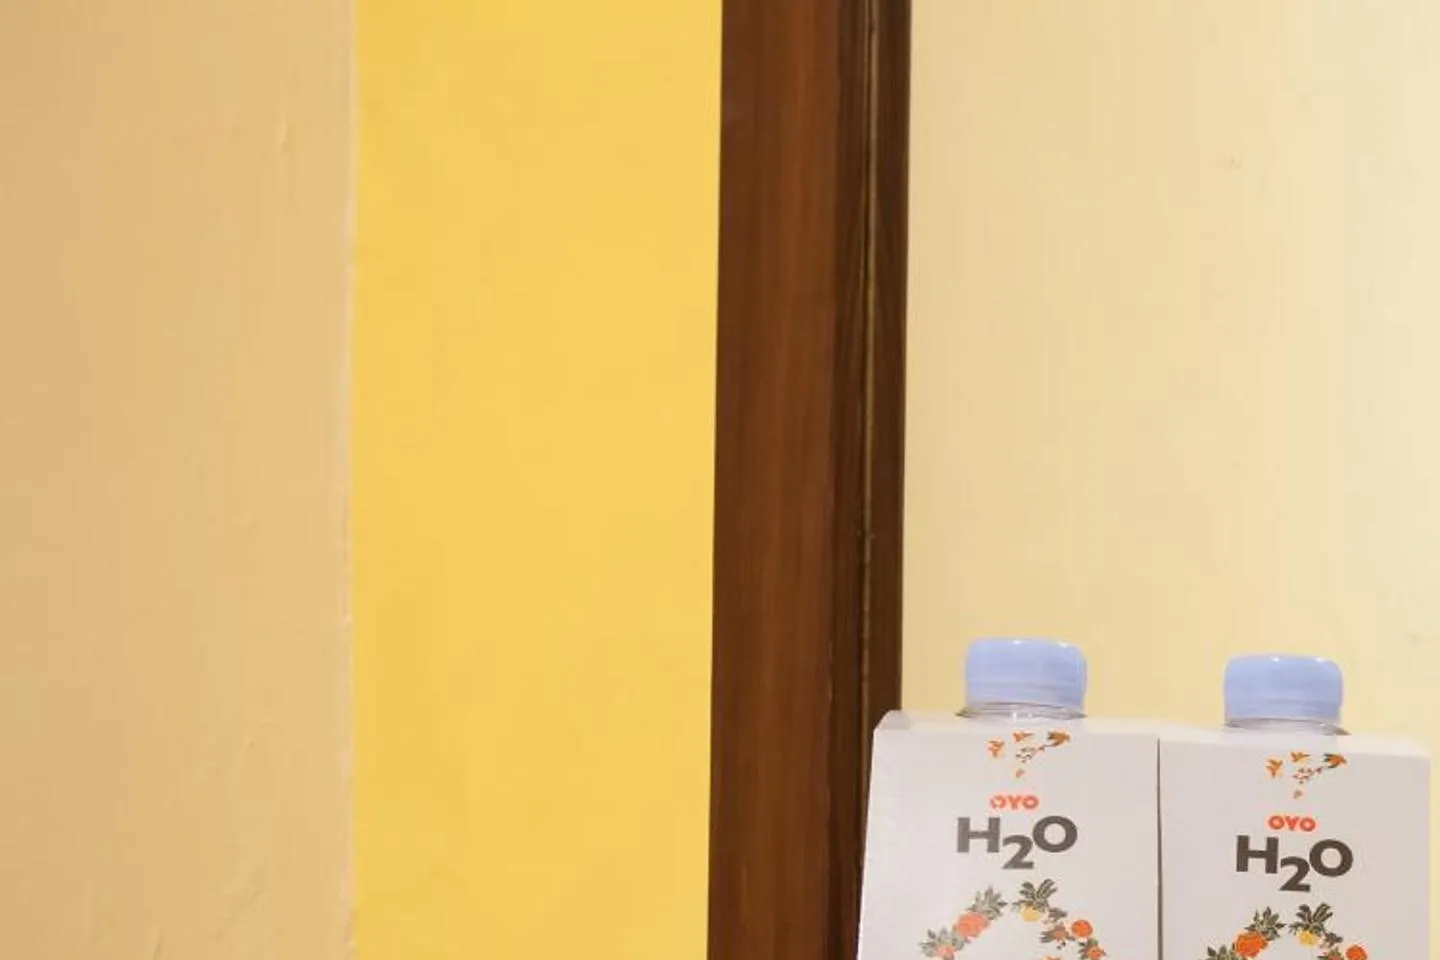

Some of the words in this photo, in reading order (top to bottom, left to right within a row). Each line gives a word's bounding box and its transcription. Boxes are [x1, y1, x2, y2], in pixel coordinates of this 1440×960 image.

[989, 794, 1040, 811] OYO
[1268, 815, 1316, 832] OYO
[956, 815, 1079, 869] H2O
[1235, 834, 1355, 892] H2O
